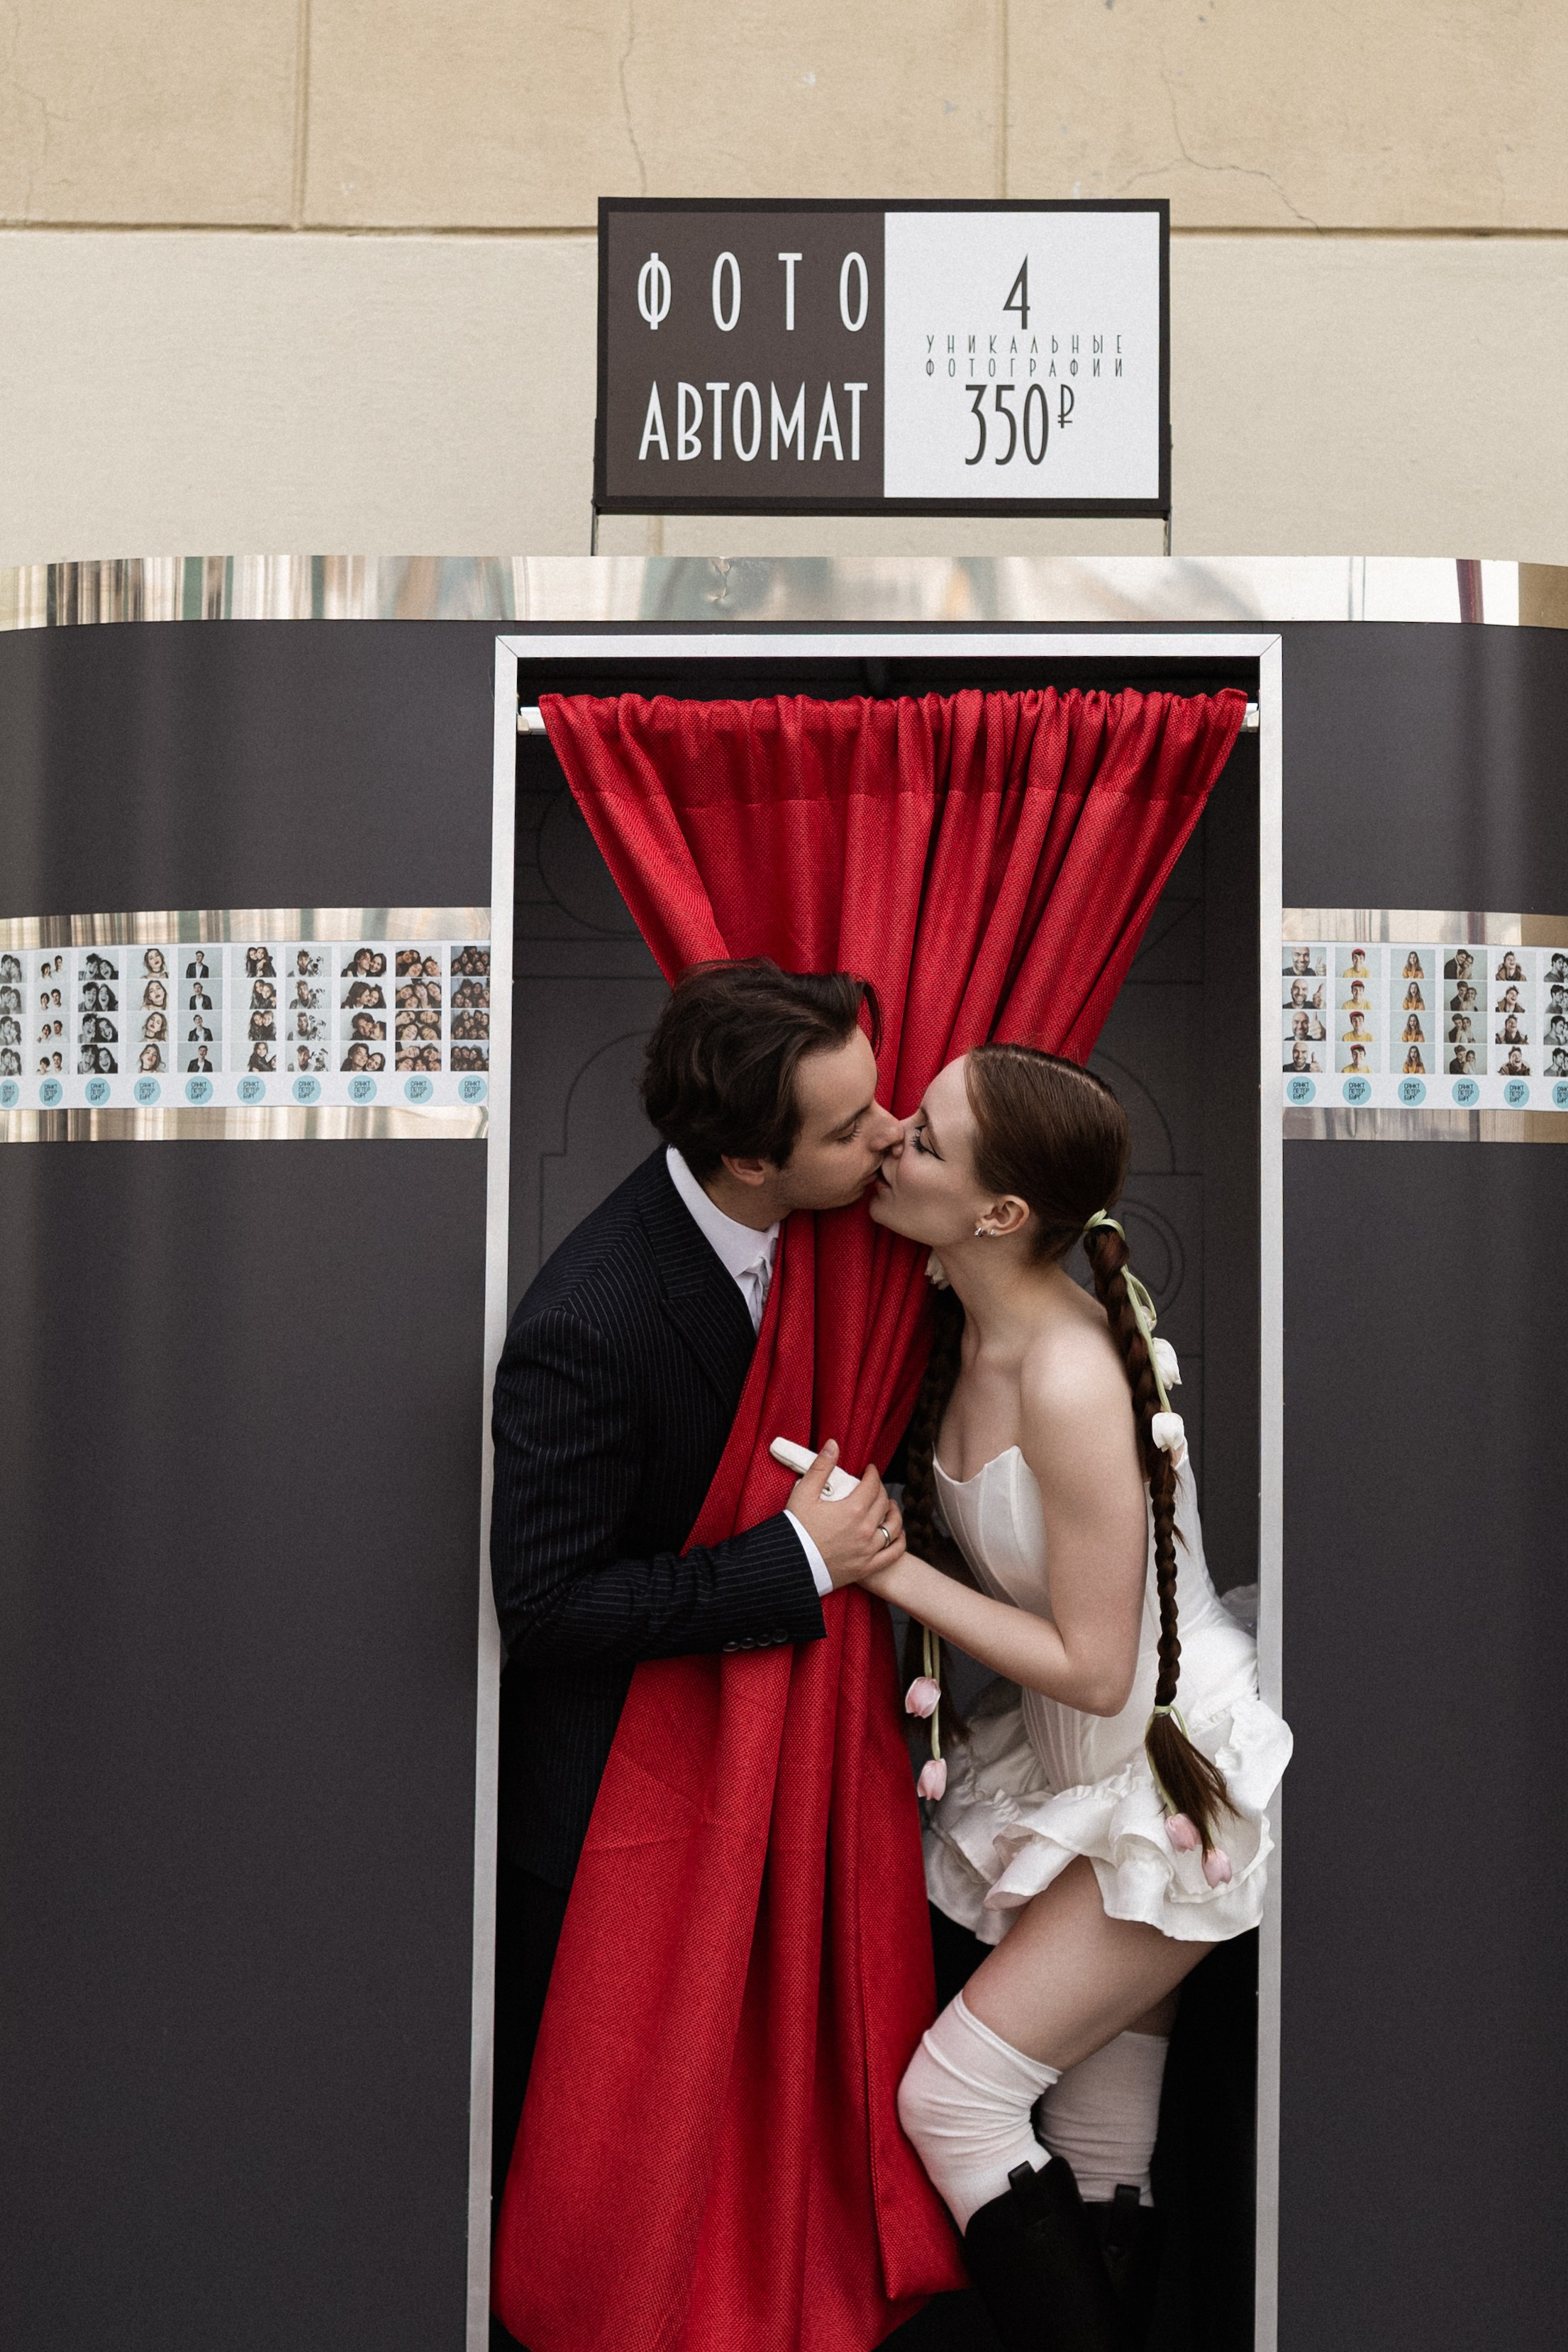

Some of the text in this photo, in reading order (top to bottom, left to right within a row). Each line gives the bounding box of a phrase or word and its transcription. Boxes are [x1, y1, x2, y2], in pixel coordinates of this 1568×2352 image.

[1002, 254, 1031, 331] 4
[925, 358, 1124, 378] ФОТОГРАФИИ
[926, 335, 1123, 355] УНИКАЛЬНЫЕ
[638, 381, 869, 462] АВТОМАТ
